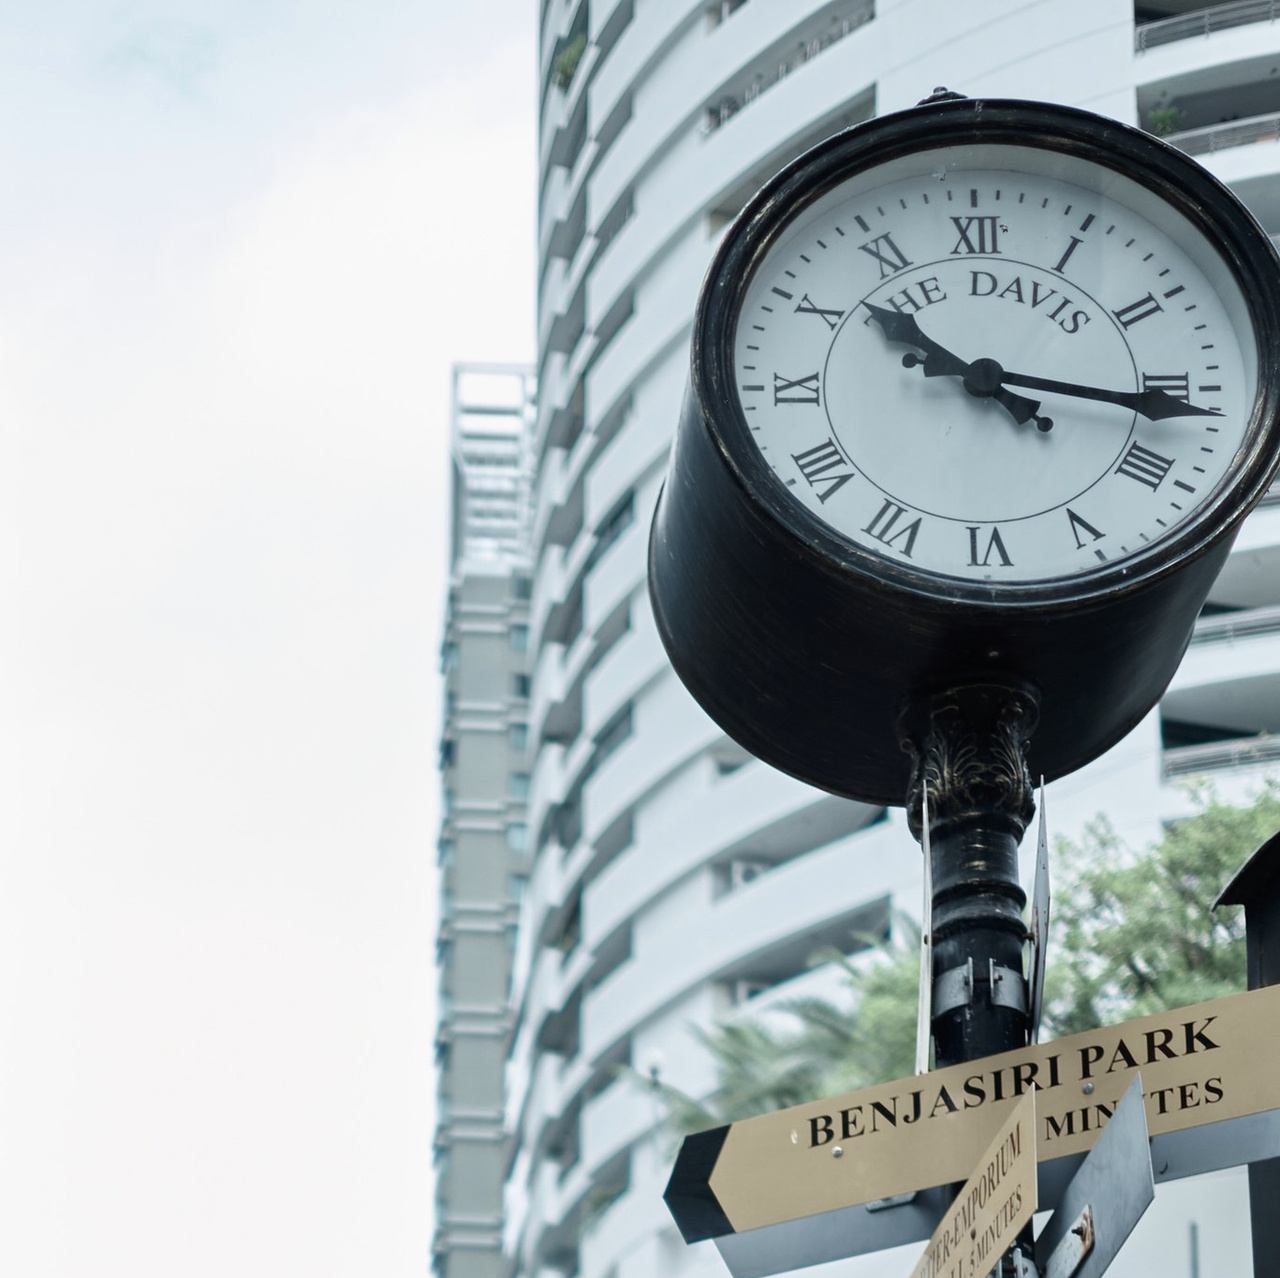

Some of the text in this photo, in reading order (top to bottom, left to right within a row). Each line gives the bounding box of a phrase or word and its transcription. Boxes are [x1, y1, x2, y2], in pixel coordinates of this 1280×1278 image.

[857, 231, 914, 281] XI
[949, 215, 1002, 255] XII
[1050, 235, 1084, 275] I
[793, 293, 846, 331] X
[863, 270, 1092, 335] HE DAVIS
[1111, 291, 1164, 331] II
[773, 371, 820, 407] IX
[790, 437, 856, 505] VIII
[1114, 440, 1176, 492] IIII
[860, 498, 923, 559] VII
[965, 526, 1015, 567] VI
[1066, 507, 1106, 550] V
[806, 1015, 1221, 1148] BENJASIRI PARK
[1044, 1077, 1224, 1141] MINTES
[976, 1183, 1023, 1268] MINUTES
